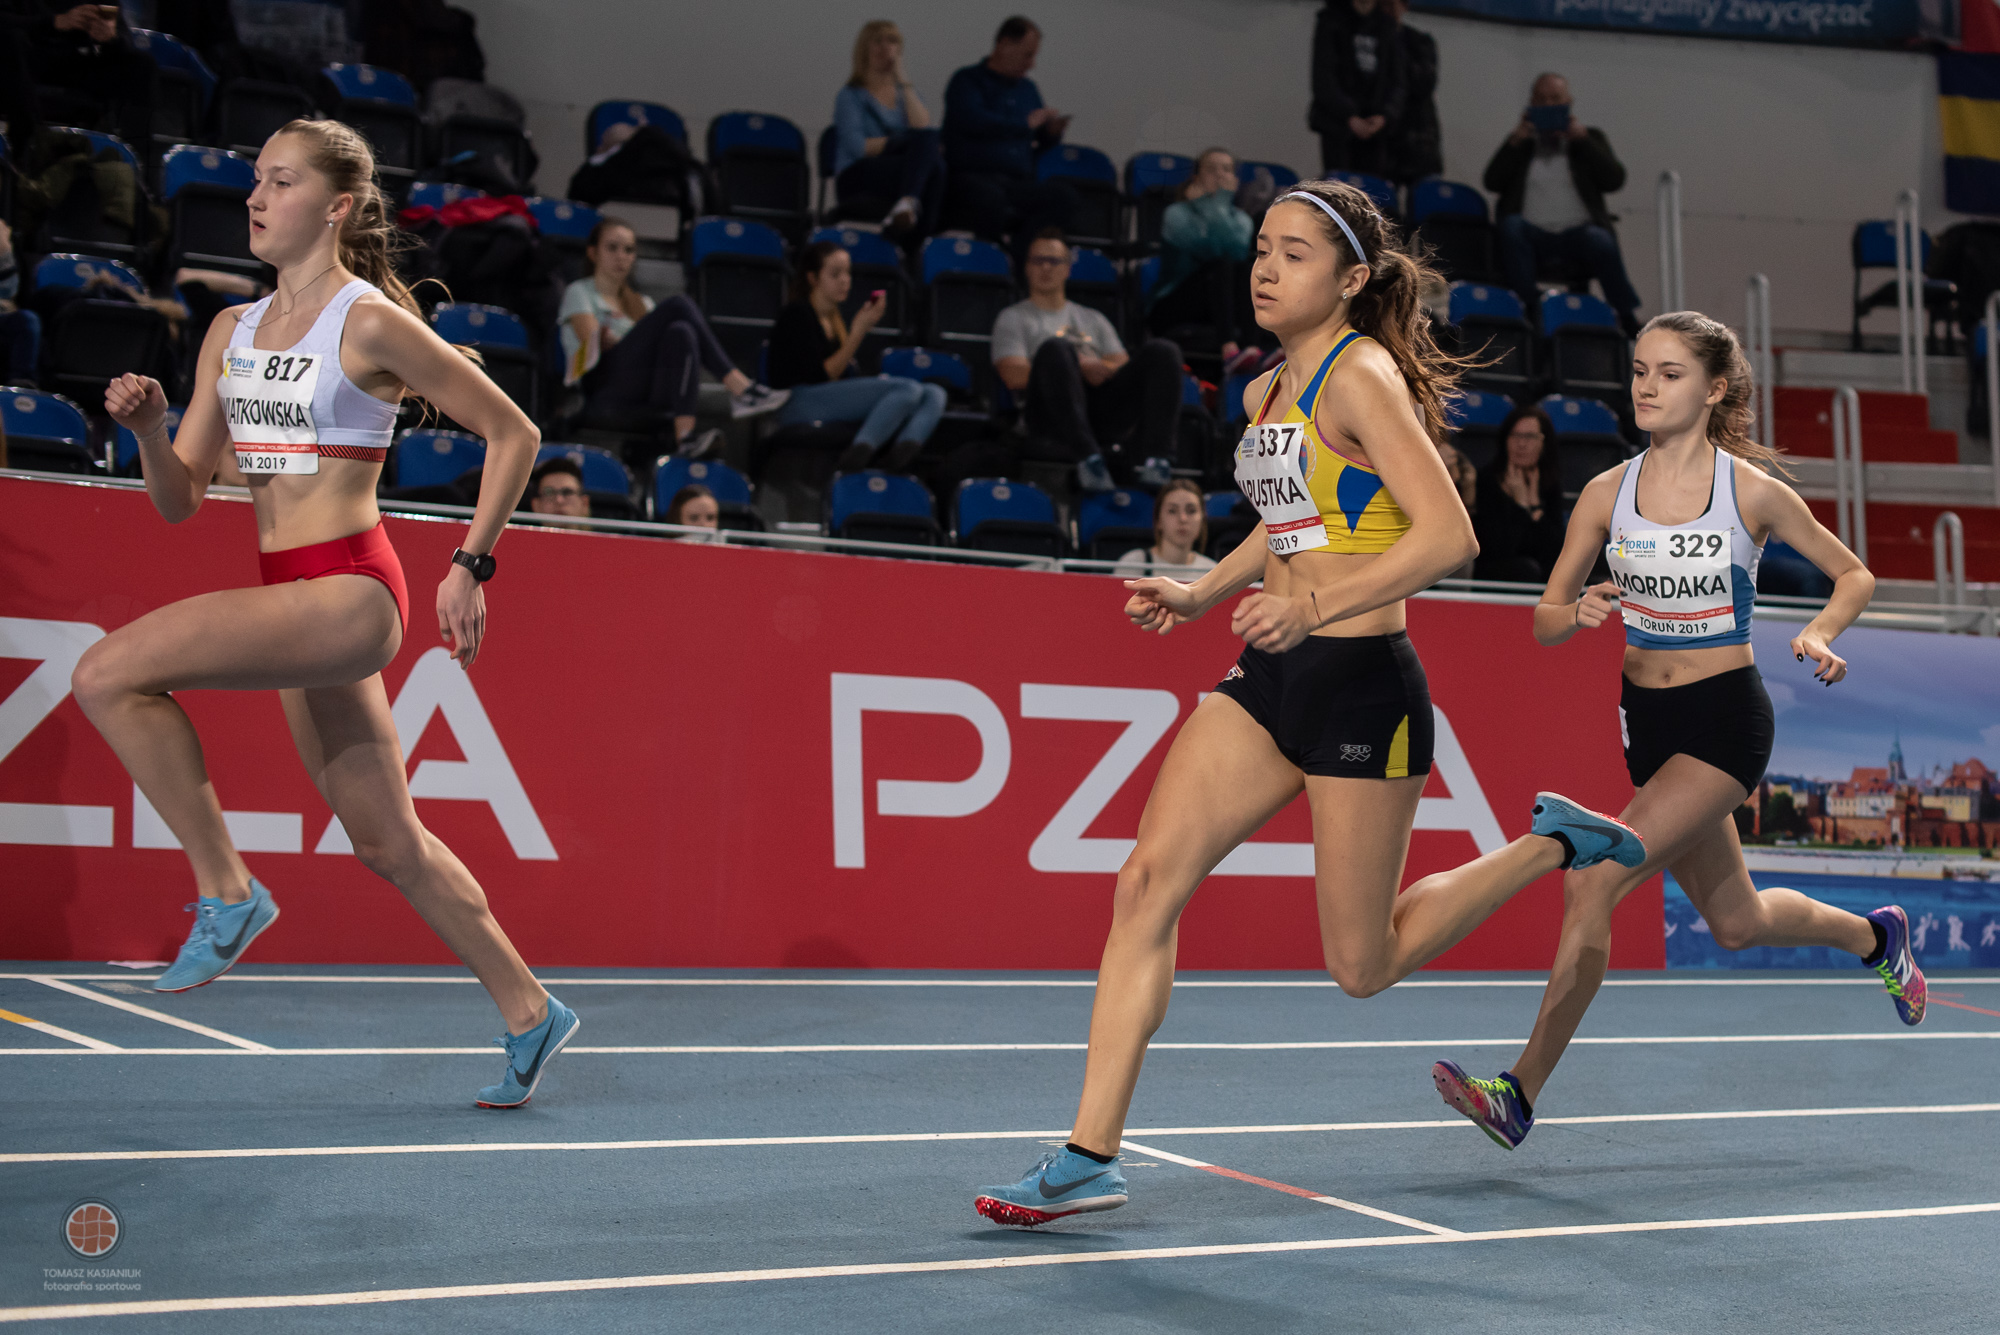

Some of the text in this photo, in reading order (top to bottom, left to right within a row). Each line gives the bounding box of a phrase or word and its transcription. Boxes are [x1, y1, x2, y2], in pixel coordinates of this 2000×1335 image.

[263, 355, 314, 382] 817
[256, 456, 287, 470] 2019
[1273, 535, 1298, 550] 2019
[1625, 537, 1656, 550] TORUŃ
[1669, 534, 1723, 558] 329
[1613, 569, 1728, 599] MORDAKA
[1639, 616, 1709, 634] TORUŃ 2019
